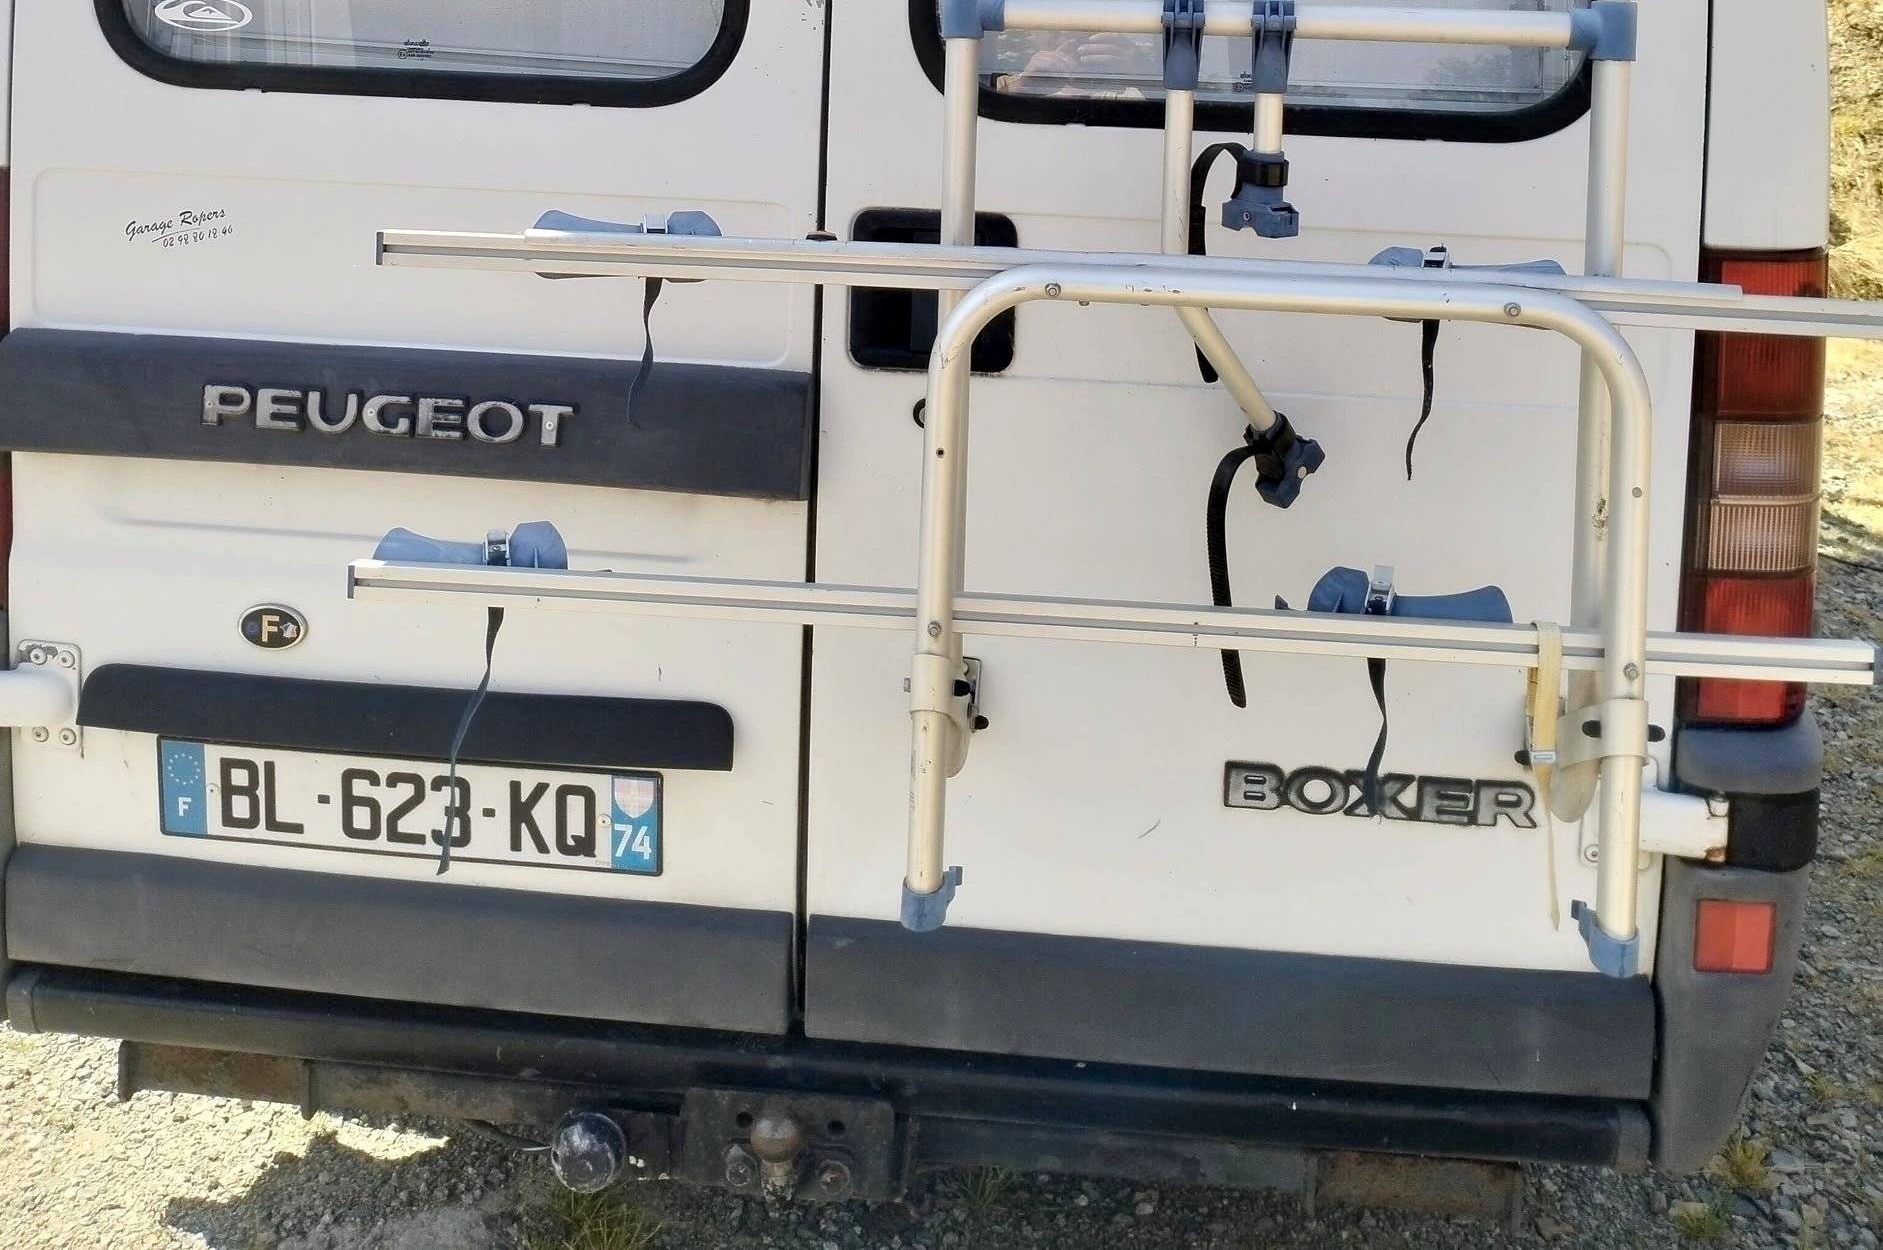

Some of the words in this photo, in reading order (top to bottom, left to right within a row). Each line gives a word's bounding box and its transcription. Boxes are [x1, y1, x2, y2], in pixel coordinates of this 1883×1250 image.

[125, 220, 173, 241] Garage
[180, 209, 225, 226] Ropers
[163, 237, 174, 247] 02
[193, 231, 204, 242] 80
[201, 384, 574, 447] PEUGEOT
[262, 614, 280, 642] F
[1224, 760, 1538, 829] BOXER
[178, 797, 191, 816] F
[614, 823, 652, 860] 74
